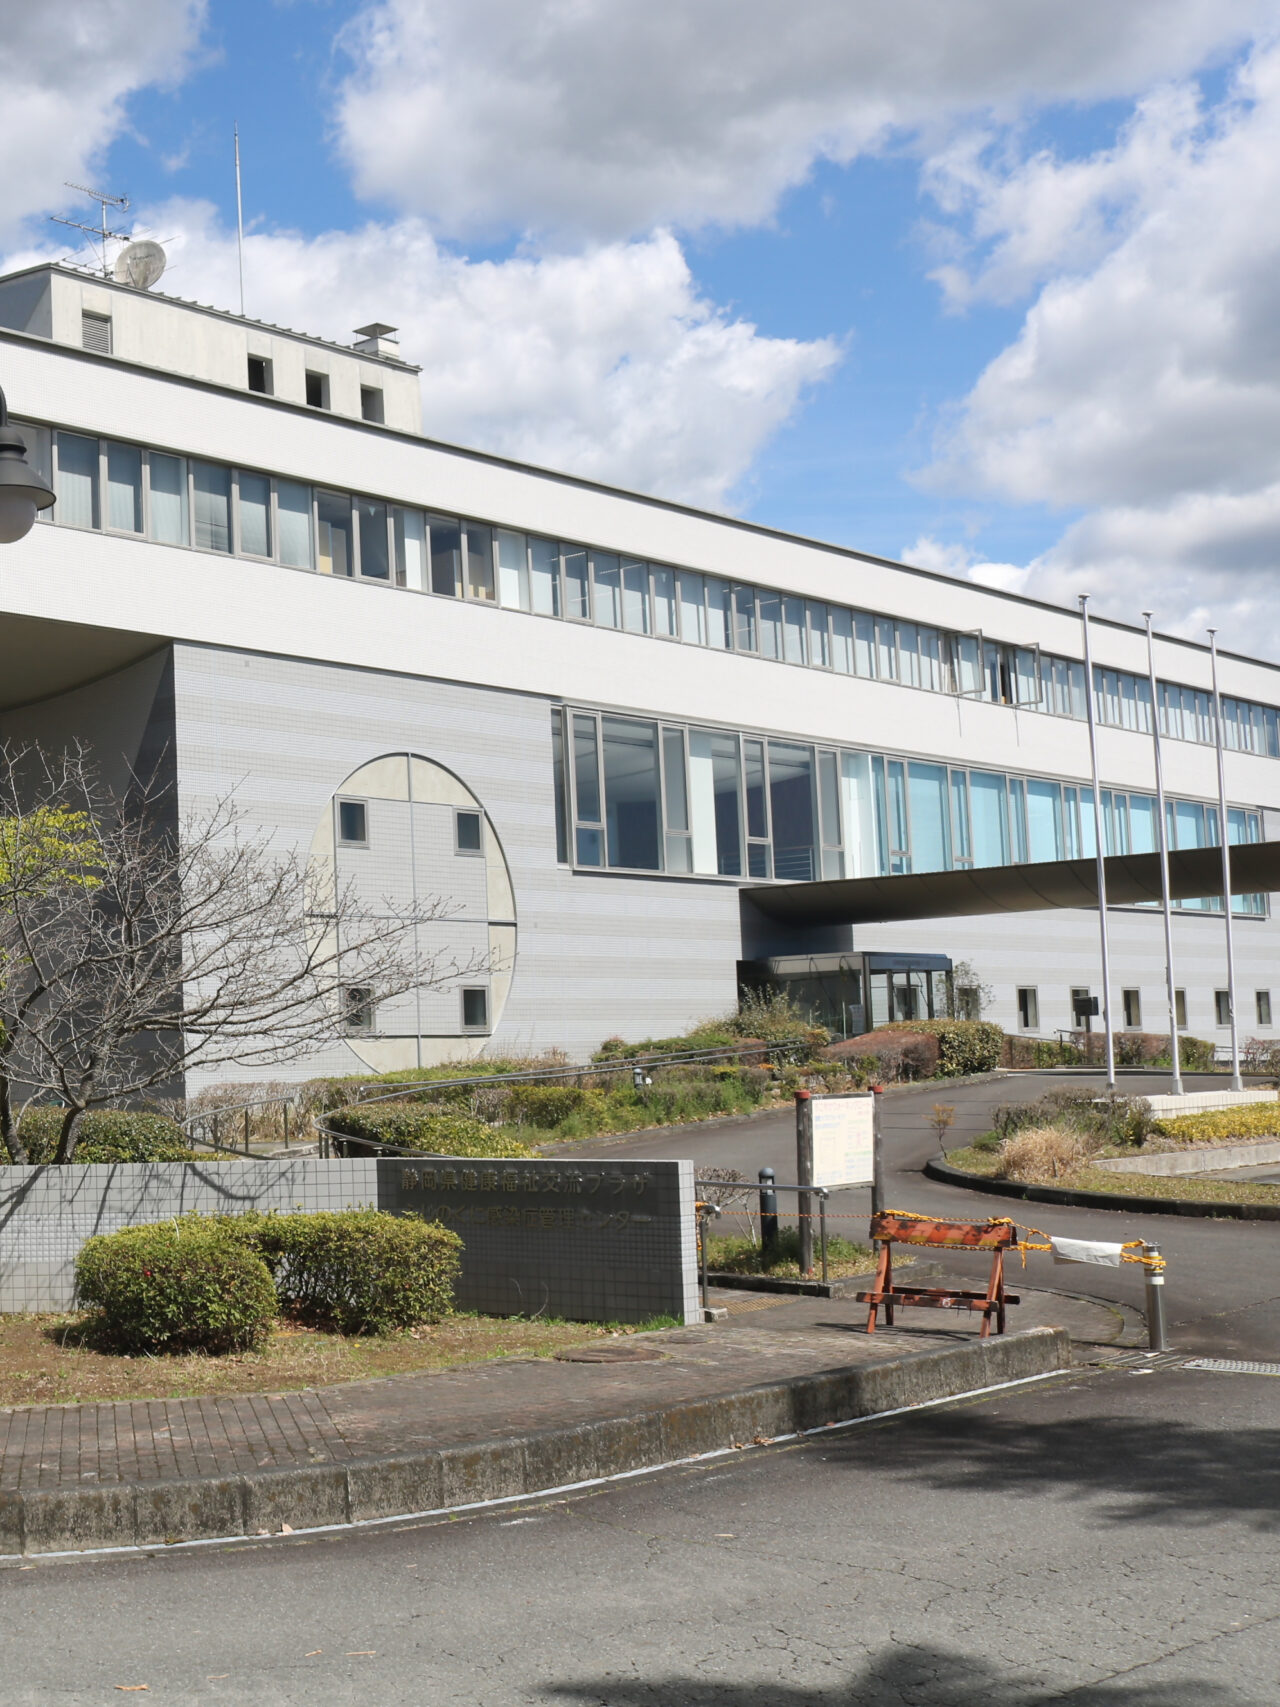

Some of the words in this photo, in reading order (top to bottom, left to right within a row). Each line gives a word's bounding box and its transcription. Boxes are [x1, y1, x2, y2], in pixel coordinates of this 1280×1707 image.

[401, 1168, 649, 1195] 静岡県健康福祉交流プラザ
[405, 1203, 653, 1232] じのくに感染症管理センター
